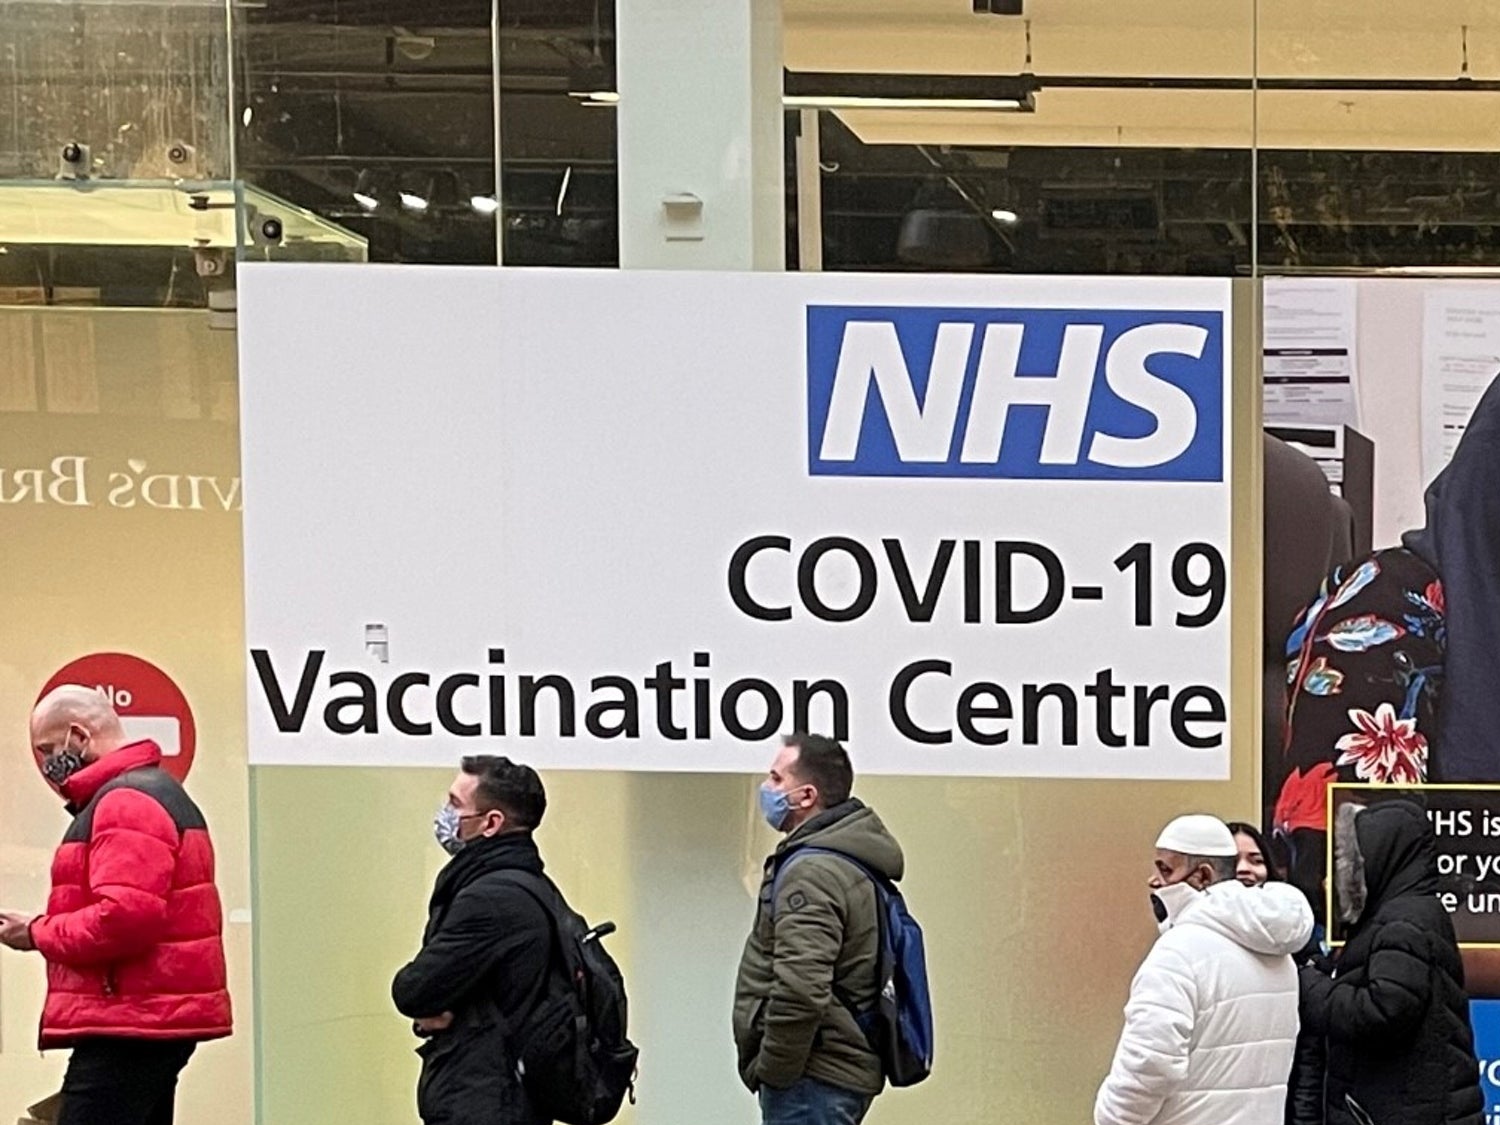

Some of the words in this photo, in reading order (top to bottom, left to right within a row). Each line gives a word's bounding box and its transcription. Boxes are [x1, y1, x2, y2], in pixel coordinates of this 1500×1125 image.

[819, 320, 1208, 468] NHS
[728, 535, 1227, 628] COVID-19
[250, 647, 849, 741] Vaccination
[889, 659, 1227, 749] Centre
[1427, 810, 1473, 836] HS
